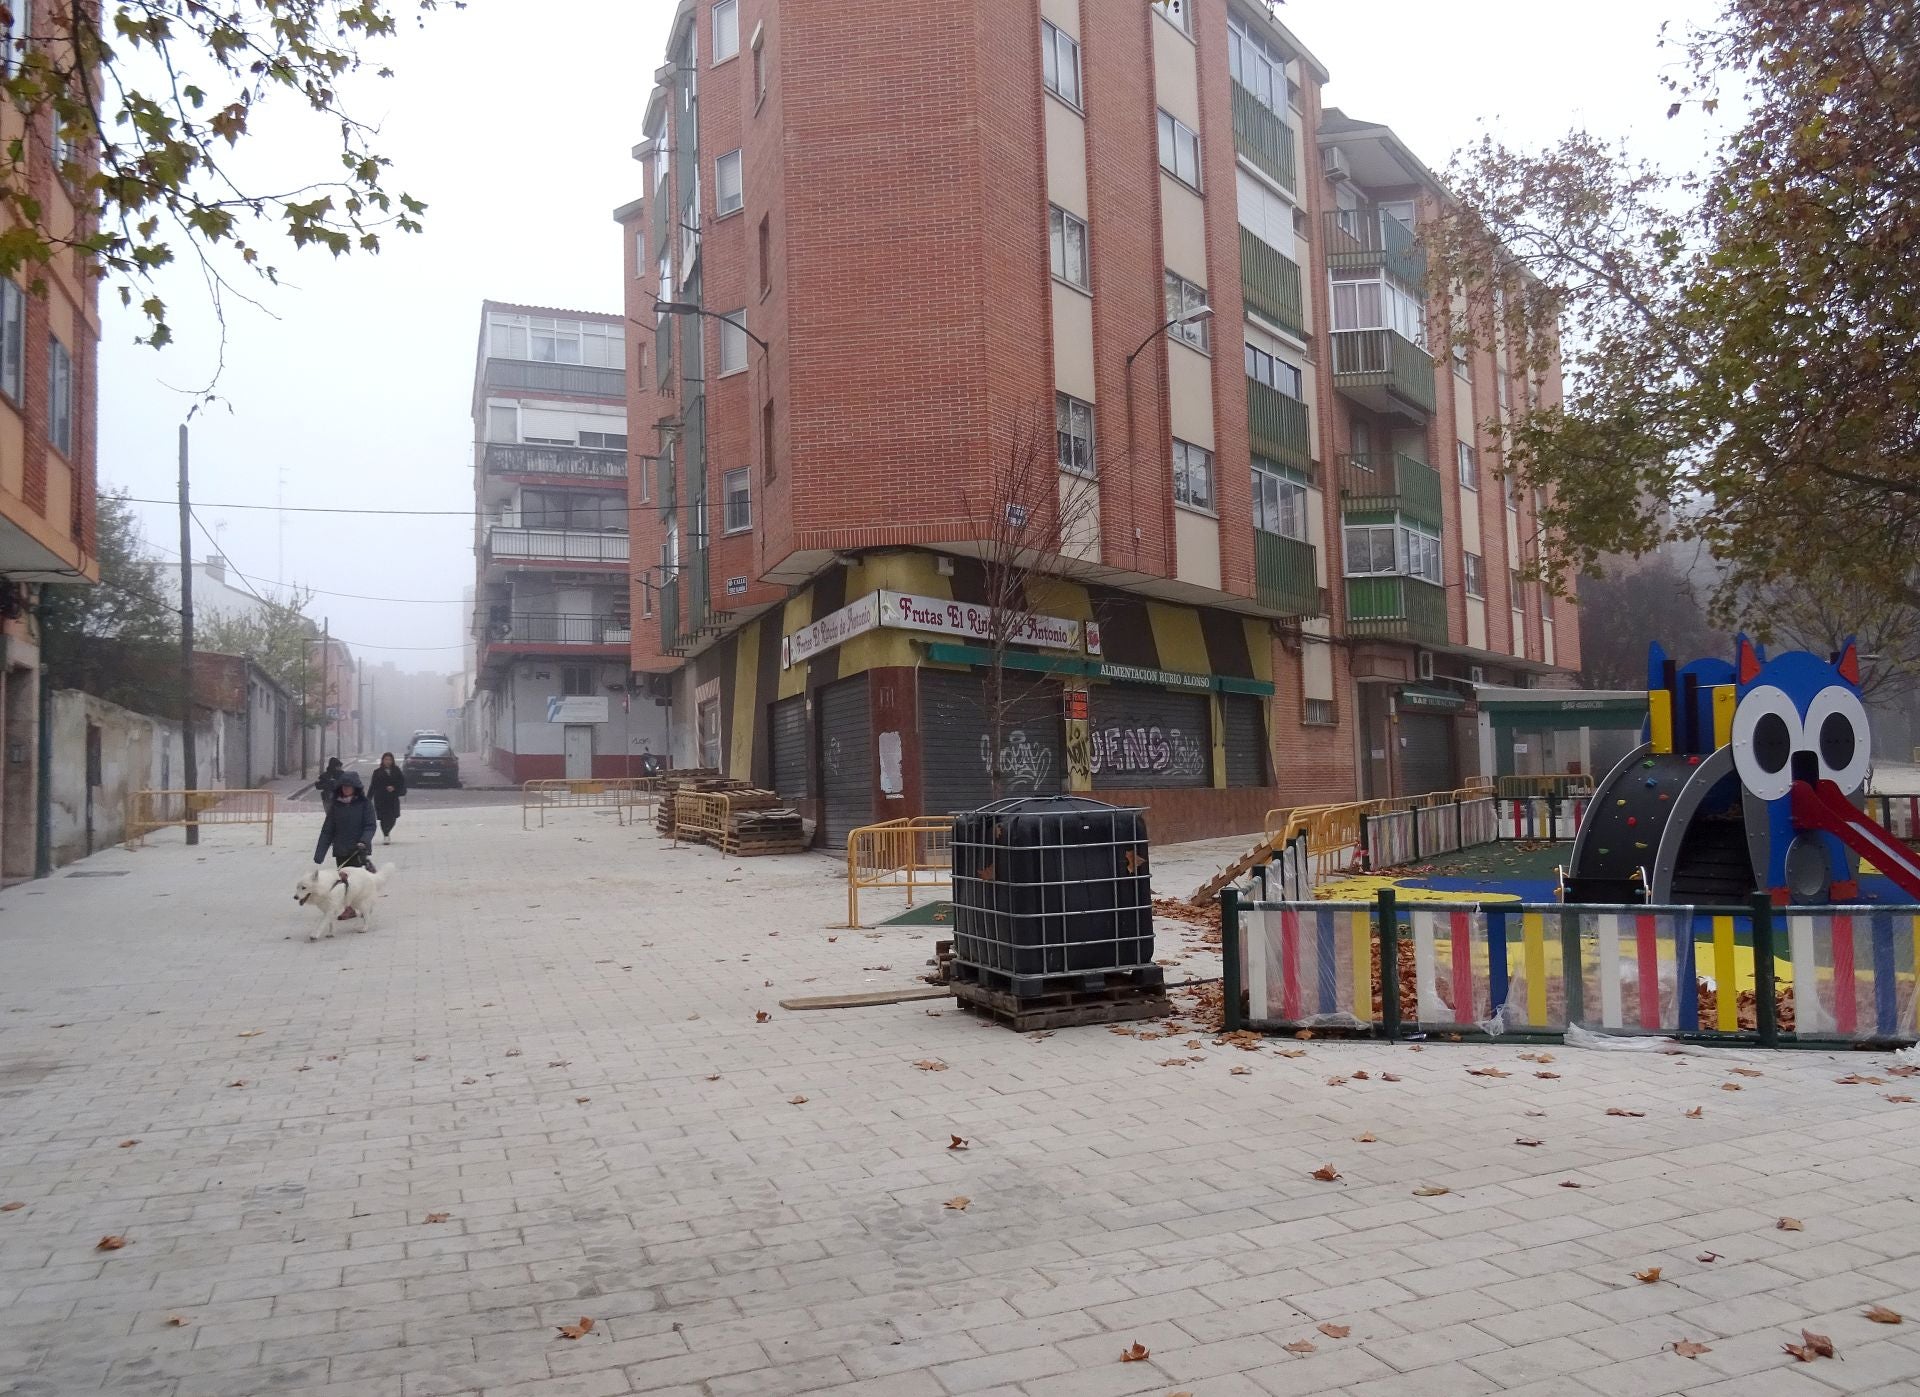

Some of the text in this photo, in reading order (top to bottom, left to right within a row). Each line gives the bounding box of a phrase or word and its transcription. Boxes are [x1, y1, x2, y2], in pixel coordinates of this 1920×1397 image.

[796, 634, 813, 654] Frutas
[813, 626, 820, 647] El
[840, 617, 846, 636] de
[847, 605, 871, 633] Antonio
[900, 597, 943, 626] Frutas
[947, 605, 964, 629] El
[967, 608, 1008, 637] Rin
[1027, 617, 1068, 644] Antonio
[1100, 663, 1210, 688] ALIMENTACION RUBIO ALONSO
[1413, 696, 1427, 704] BAR
